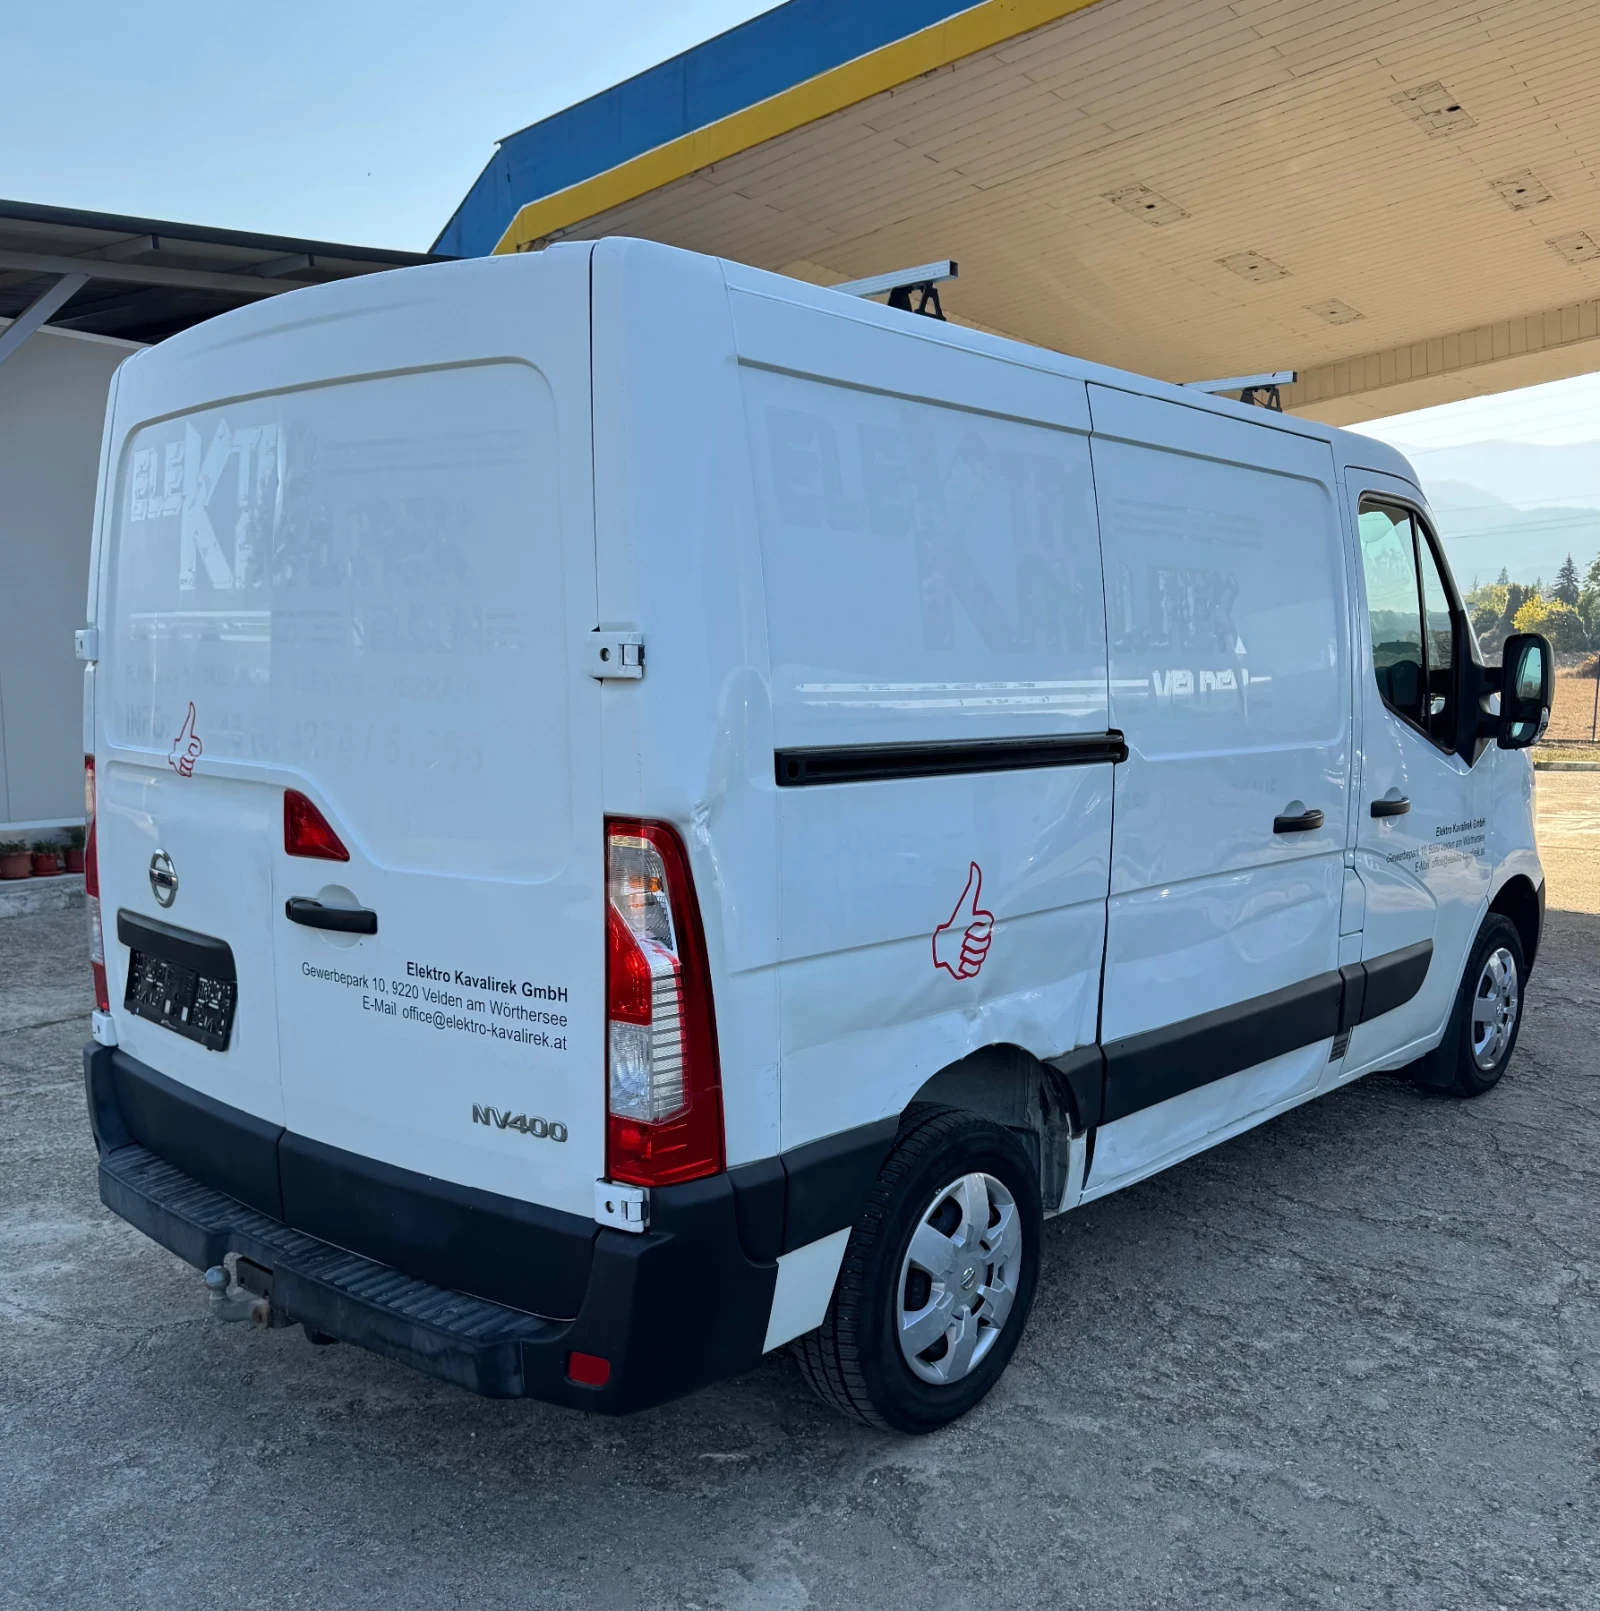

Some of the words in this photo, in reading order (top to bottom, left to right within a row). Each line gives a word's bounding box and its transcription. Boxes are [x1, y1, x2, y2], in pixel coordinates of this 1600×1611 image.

[301, 961, 369, 988] Gewerbepark
[372, 976, 389, 996] 10,
[391, 980, 419, 1000] 9220
[422, 986, 463, 1009] Velden
[466, 999, 486, 1013] am
[489, 999, 568, 1027] Wörthersee
[406, 961, 451, 983] Elektro
[454, 969, 517, 995] Kavalirek
[521, 981, 568, 1003] GmbH
[362, 995, 397, 1016] E-Mail
[402, 1005, 568, 1051] office@elektro-kavalirek.at
[472, 1102, 568, 1142] NV400
